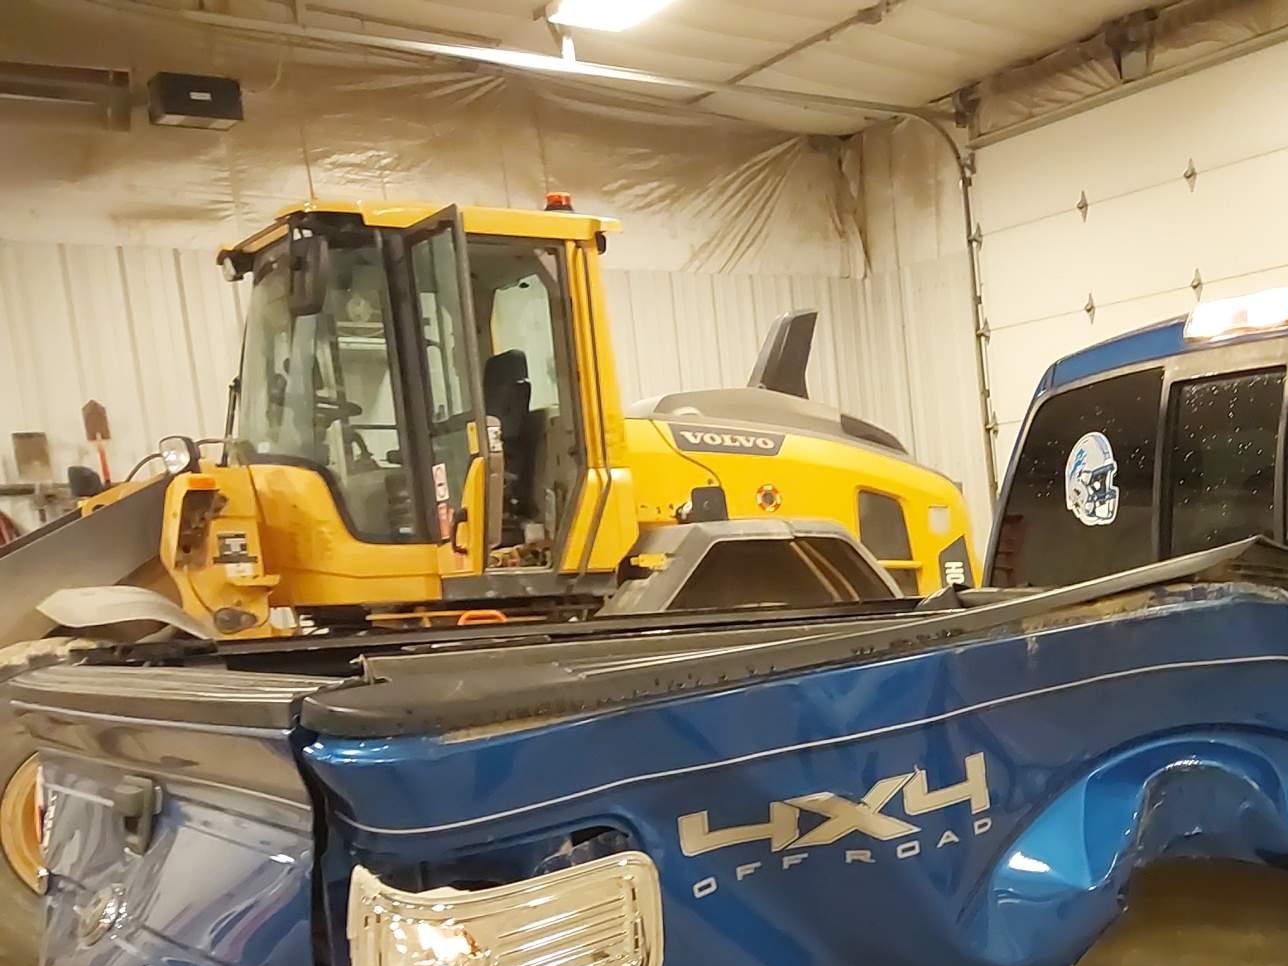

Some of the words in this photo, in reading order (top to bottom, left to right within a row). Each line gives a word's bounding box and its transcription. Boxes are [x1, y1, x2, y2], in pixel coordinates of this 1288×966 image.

[679, 430, 775, 449] VOLVO
[692, 852, 809, 899] OFF
[845, 817, 993, 864] ROAD
